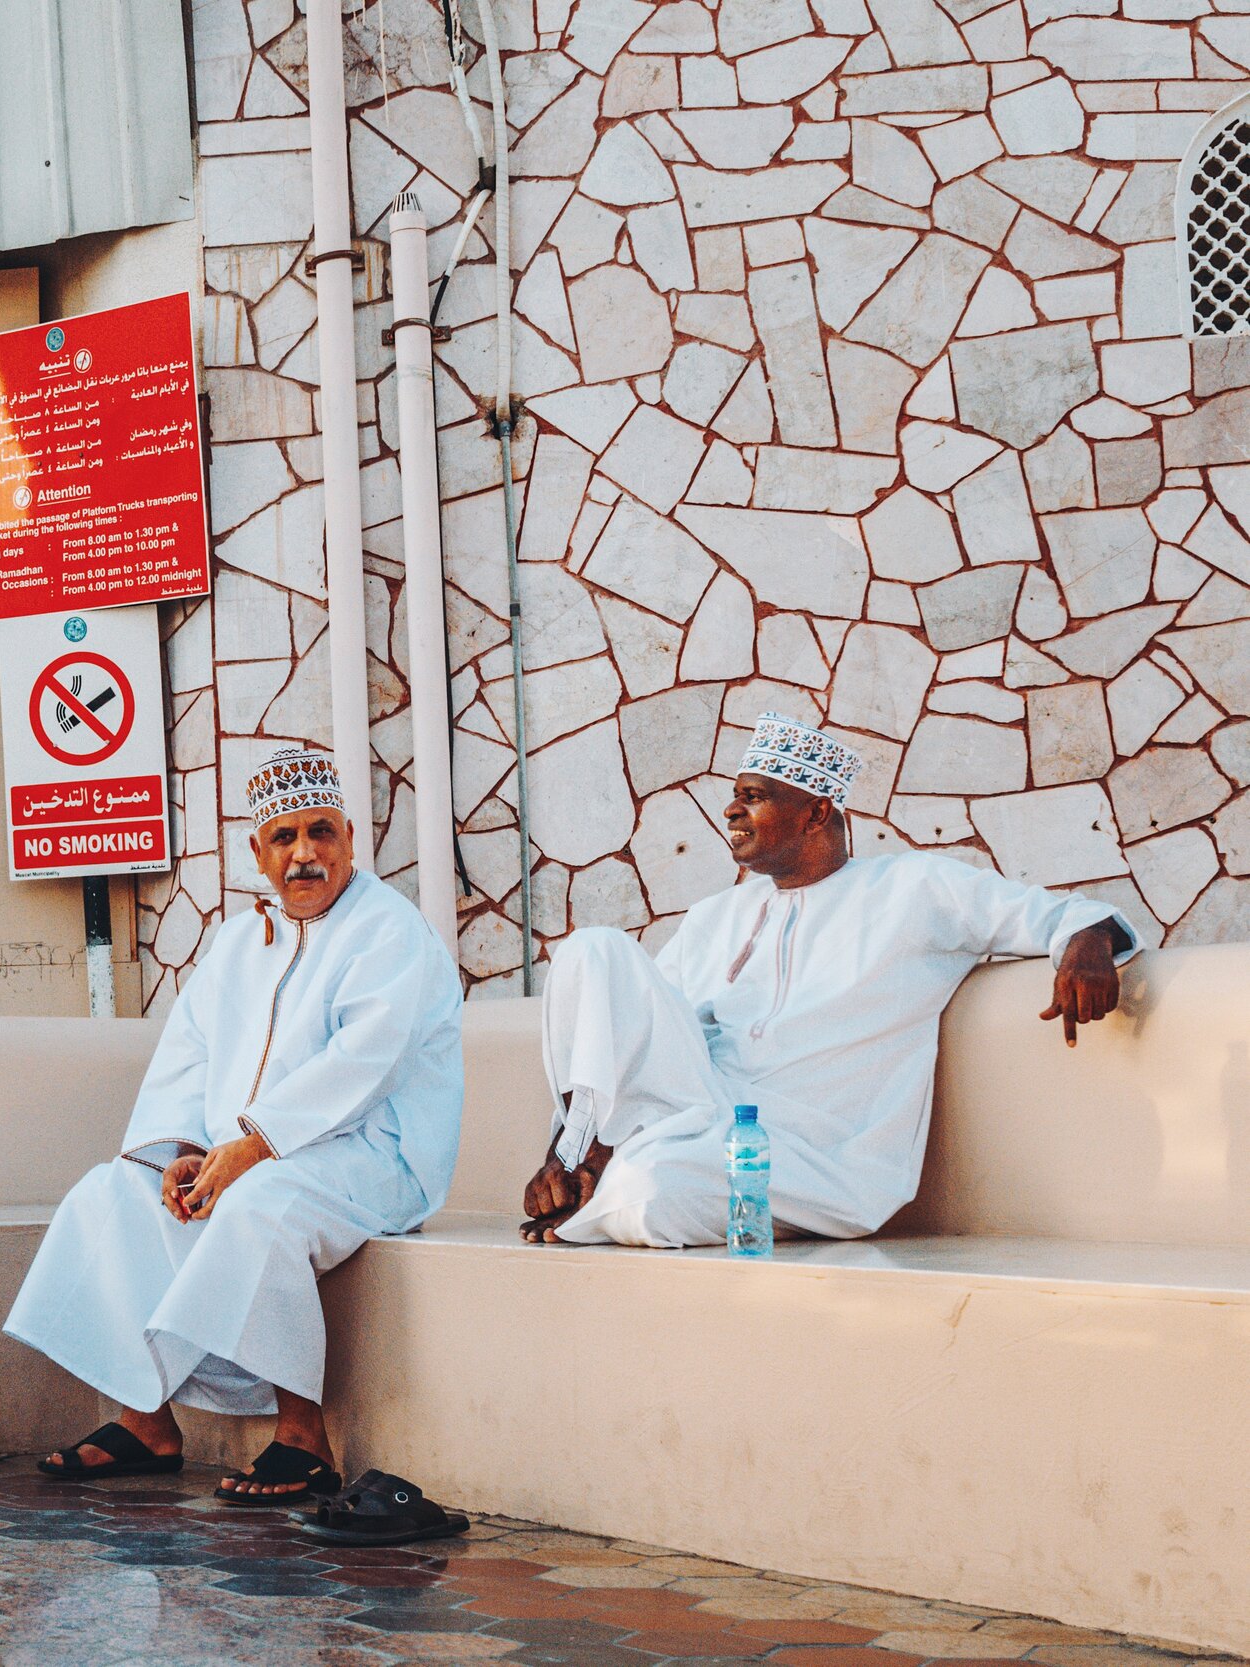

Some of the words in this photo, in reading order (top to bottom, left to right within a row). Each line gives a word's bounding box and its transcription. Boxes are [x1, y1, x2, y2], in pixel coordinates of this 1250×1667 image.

[39, 354, 70, 373] تنبيه
[38, 485, 91, 503] Attention
[21, 518, 34, 527] the
[36, 512, 69, 528] passage
[72, 509, 80, 519] of
[82, 505, 116, 517] Platform
[117, 501, 144, 511] Trucks
[146, 491, 198, 506] transporting
[12, 527, 39, 538] during
[41, 524, 54, 534] the
[56, 519, 93, 532] following
[95, 515, 117, 526] times
[3, 547, 24, 558] days
[63, 537, 86, 548] From
[87, 535, 106, 545] 8.00
[108, 533, 122, 542] am
[124, 531, 132, 540] to
[135, 527, 153, 537] 1.30
[155, 525, 170, 537] pm
[172, 522, 179, 532] &
[62, 551, 86, 562] From
[87, 548, 106, 559] 4.00
[108, 547, 122, 558] pm
[124, 544, 133, 553] to
[136, 540, 159, 551] 10.00
[161, 538, 175, 550] pm
[2, 576, 49, 590] Occasions
[62, 571, 85, 582] From
[87, 569, 106, 579] 8.00
[108, 567, 121, 576] am
[123, 564, 132, 573] to
[134, 561, 153, 572] 1.30
[155, 560, 169, 571] pm
[171, 557, 179, 566] &
[62, 585, 86, 596] From
[87, 581, 106, 592] 4.00
[108, 580, 122, 592] pm
[124, 577, 134, 586] to
[136, 574, 159, 585] 12.00
[161, 568, 202, 581] midnight
[161, 587, 185, 596] مسقط
[186, 584, 203, 594] بلدية
[22, 787, 89, 818] التدخين
[93, 786, 150, 814] ممنوع
[24, 837, 53, 857] NO
[59, 831, 154, 855] SMOKING
